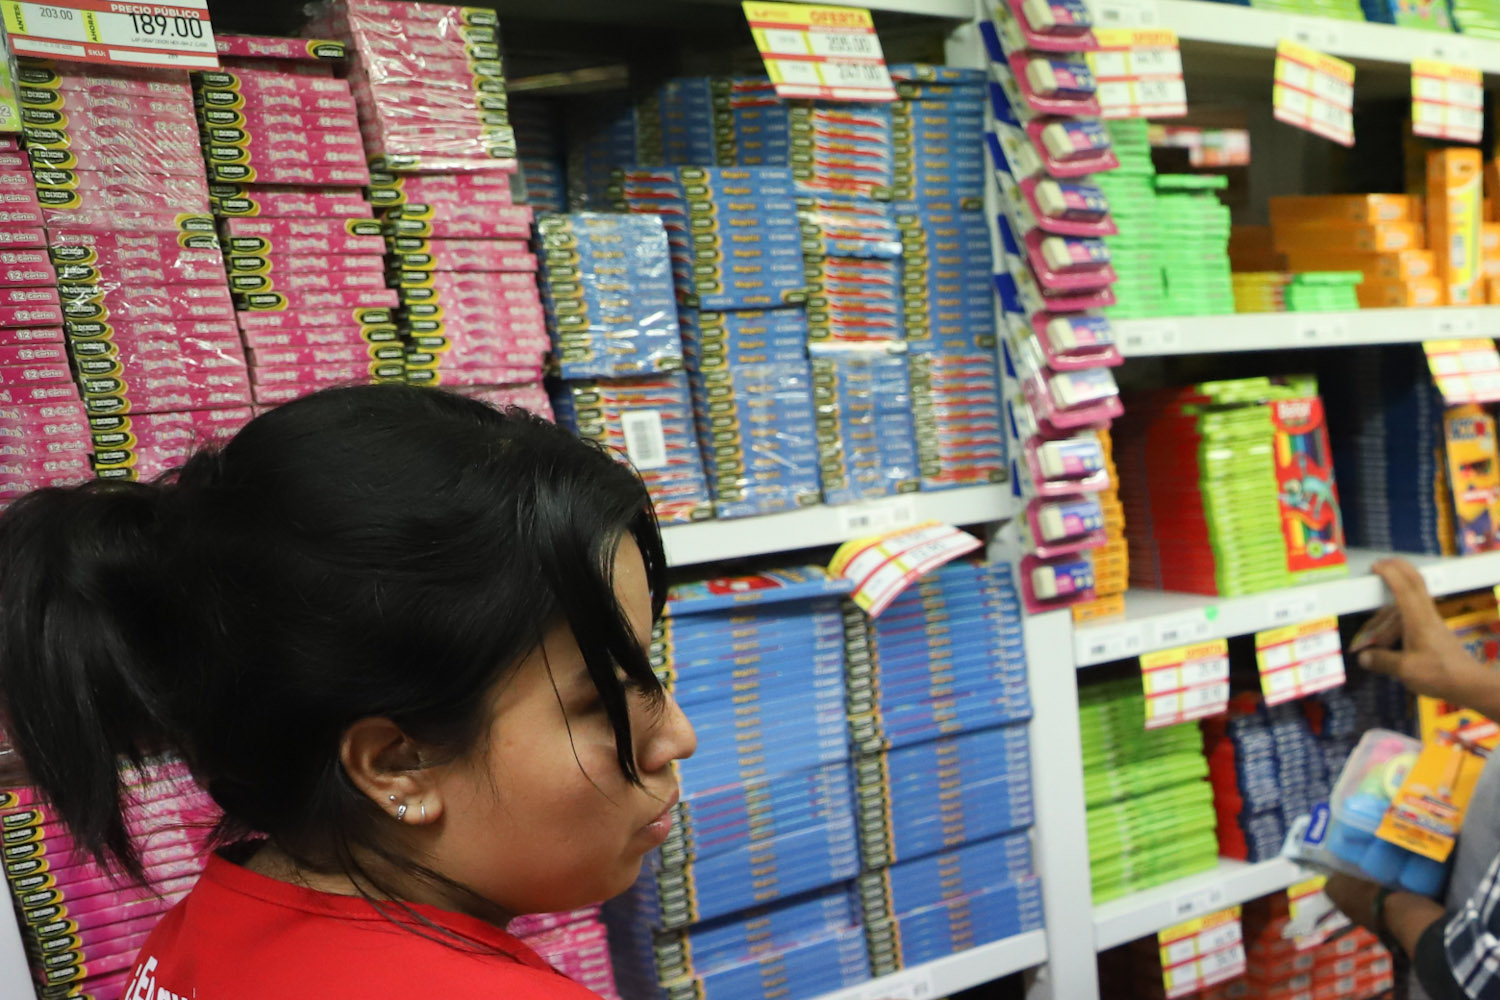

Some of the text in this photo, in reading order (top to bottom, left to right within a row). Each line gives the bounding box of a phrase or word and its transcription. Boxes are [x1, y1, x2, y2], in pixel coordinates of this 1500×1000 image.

[40, 7, 73, 21] 203.00
[110, 4, 200, 19] PRECIO PÚBLICO
[129, 13, 204, 39] 189.00
[45, 191, 69, 199] DIXON
